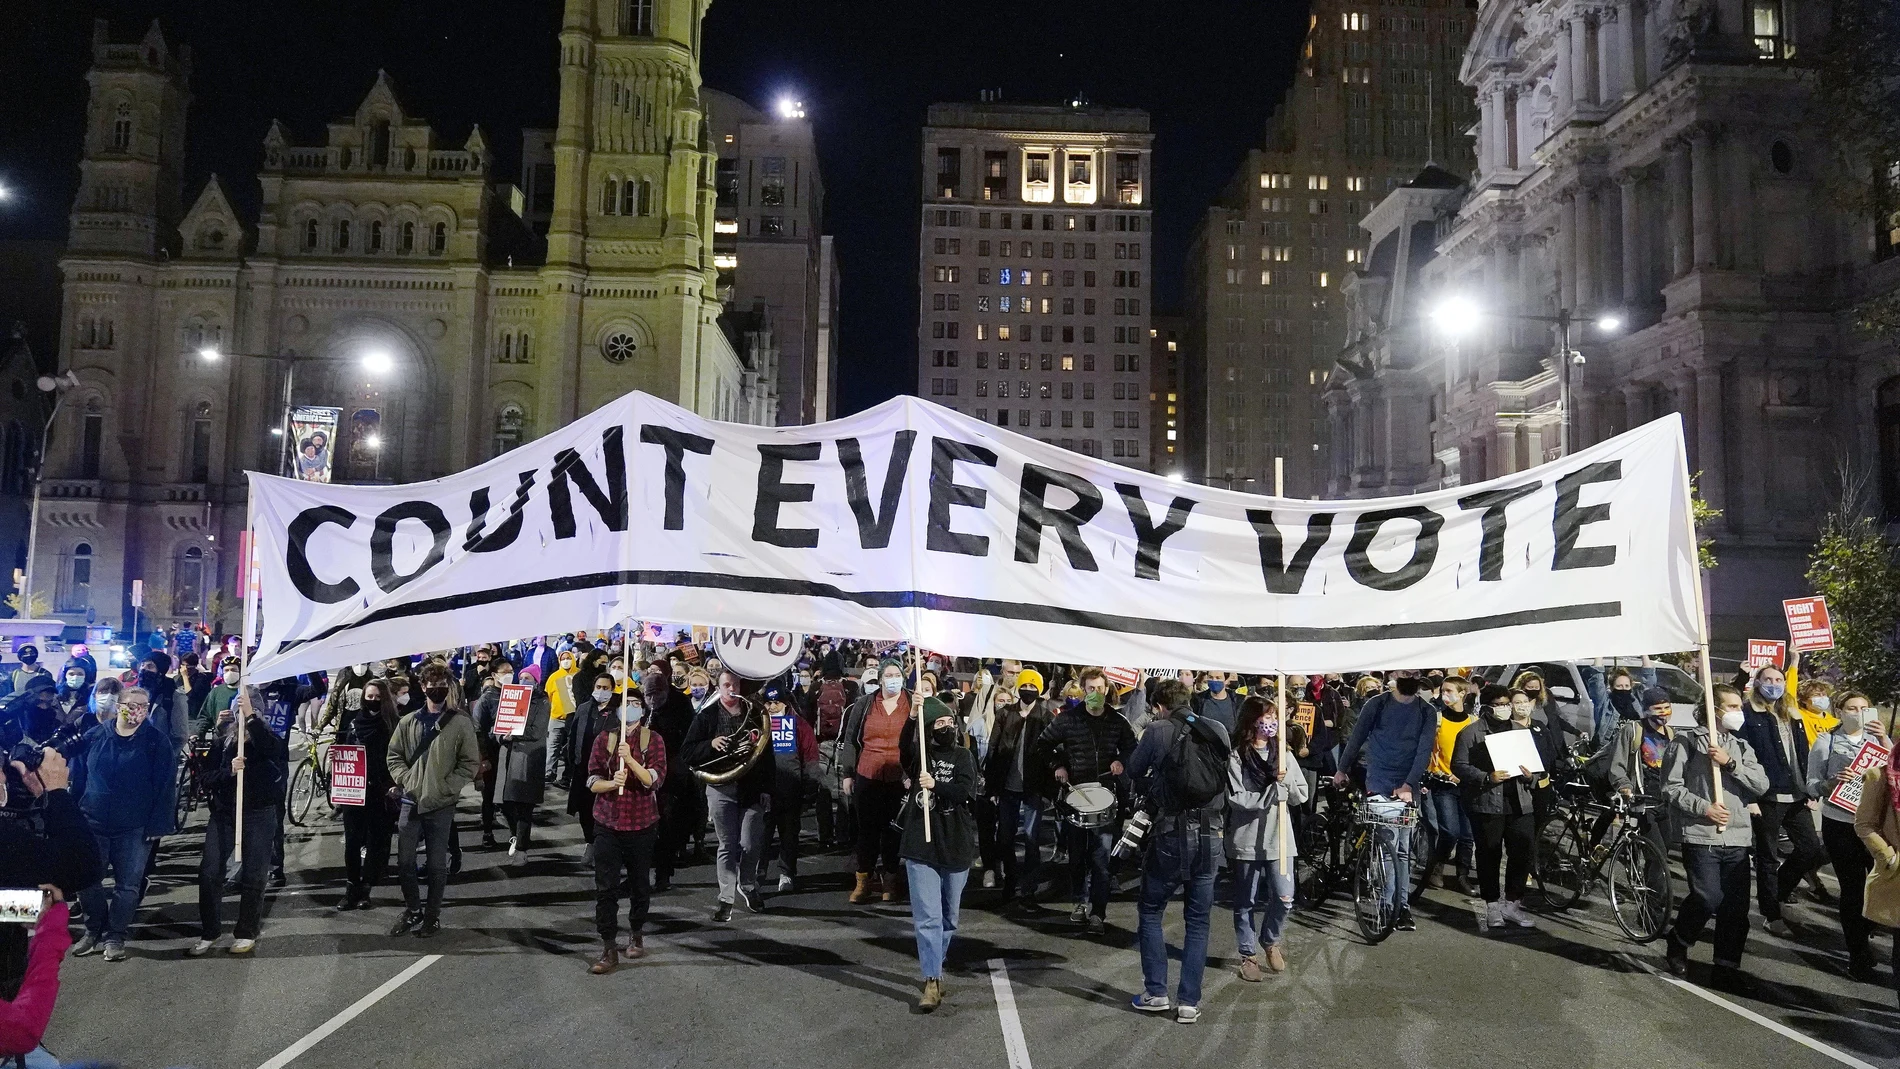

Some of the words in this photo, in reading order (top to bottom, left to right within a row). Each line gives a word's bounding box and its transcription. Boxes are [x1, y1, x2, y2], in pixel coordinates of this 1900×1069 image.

[286, 423, 715, 604] COUNT
[751, 429, 1199, 581] EVERY
[1246, 458, 1624, 595] VOTE
[1787, 602, 1815, 615] FIGHT
[1751, 644, 1778, 656] BLACK
[503, 689, 524, 700] FIGHT
[771, 731, 794, 741] RIS
[335, 762, 355, 774] LIVES
[334, 774, 365, 787] MATTER
[1839, 790, 1860, 803] EVERY
